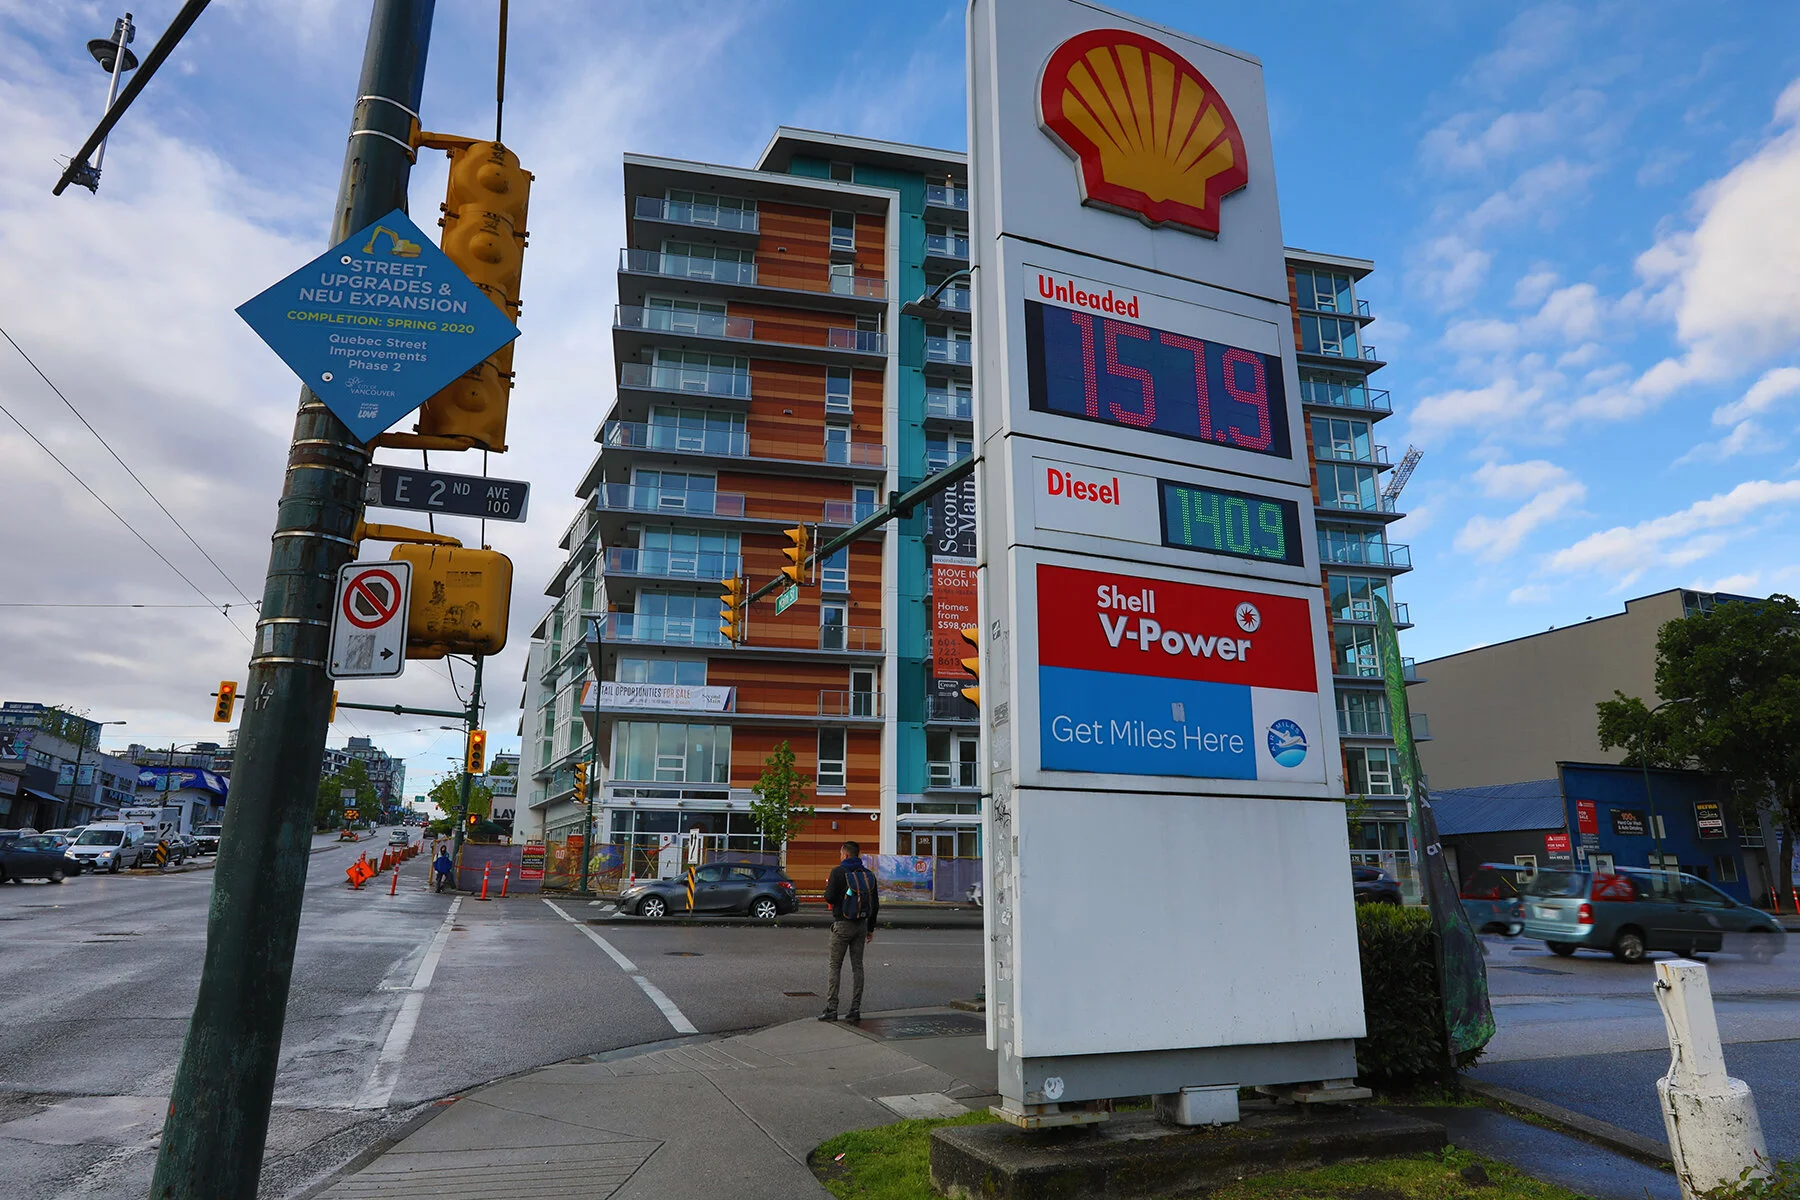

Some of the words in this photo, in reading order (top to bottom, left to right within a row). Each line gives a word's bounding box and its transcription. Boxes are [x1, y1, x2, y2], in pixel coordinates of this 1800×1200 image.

[350, 259, 427, 278] STREET
[320, 272, 433, 294] UPGRADES
[438, 283, 452, 296] &
[299, 288, 343, 303] NEU
[349, 292, 467, 314] EXPANSION
[1038, 274, 1139, 318] Unleaded
[287, 310, 383, 327] COMPLETION:
[386, 318, 437, 331] SPRING
[440, 322, 475, 335] 2020
[329, 333, 382, 347] Quebec
[386, 338, 428, 350] Street
[329, 346, 428, 362] Improvements
[348, 359, 389, 371] Phase
[393, 362, 401, 372] 2
[1071, 311, 1272, 450] 157.9
[350, 388, 396, 397] VANCOUVER
[357, 410, 379, 419] LOVE
[395, 476, 413, 503] E
[486, 486, 510, 500] AVE
[1047, 467, 1120, 505] Diesel
[487, 501, 510, 514] 100
[1176, 488, 1286, 560] 140.9
[937, 568, 967, 579] MOVE
[937, 578, 969, 588] SOON
[937, 602, 969, 612] Homes
[1096, 584, 1156, 614] Shell
[937, 610, 960, 620] from
[937, 620, 977, 631] $598,900
[1097, 612, 1251, 663] V-Power
[938, 657, 960, 667] 8613
[615, 686, 662, 698] OPPORTUNITIES
[663, 688, 674, 699] FOR
[675, 688, 691, 699] SALE
[1051, 714, 1103, 745] Get
[1110, 719, 1177, 750] Miles
[1183, 724, 1244, 754] Here
[1275, 721, 1300, 735] MILES
